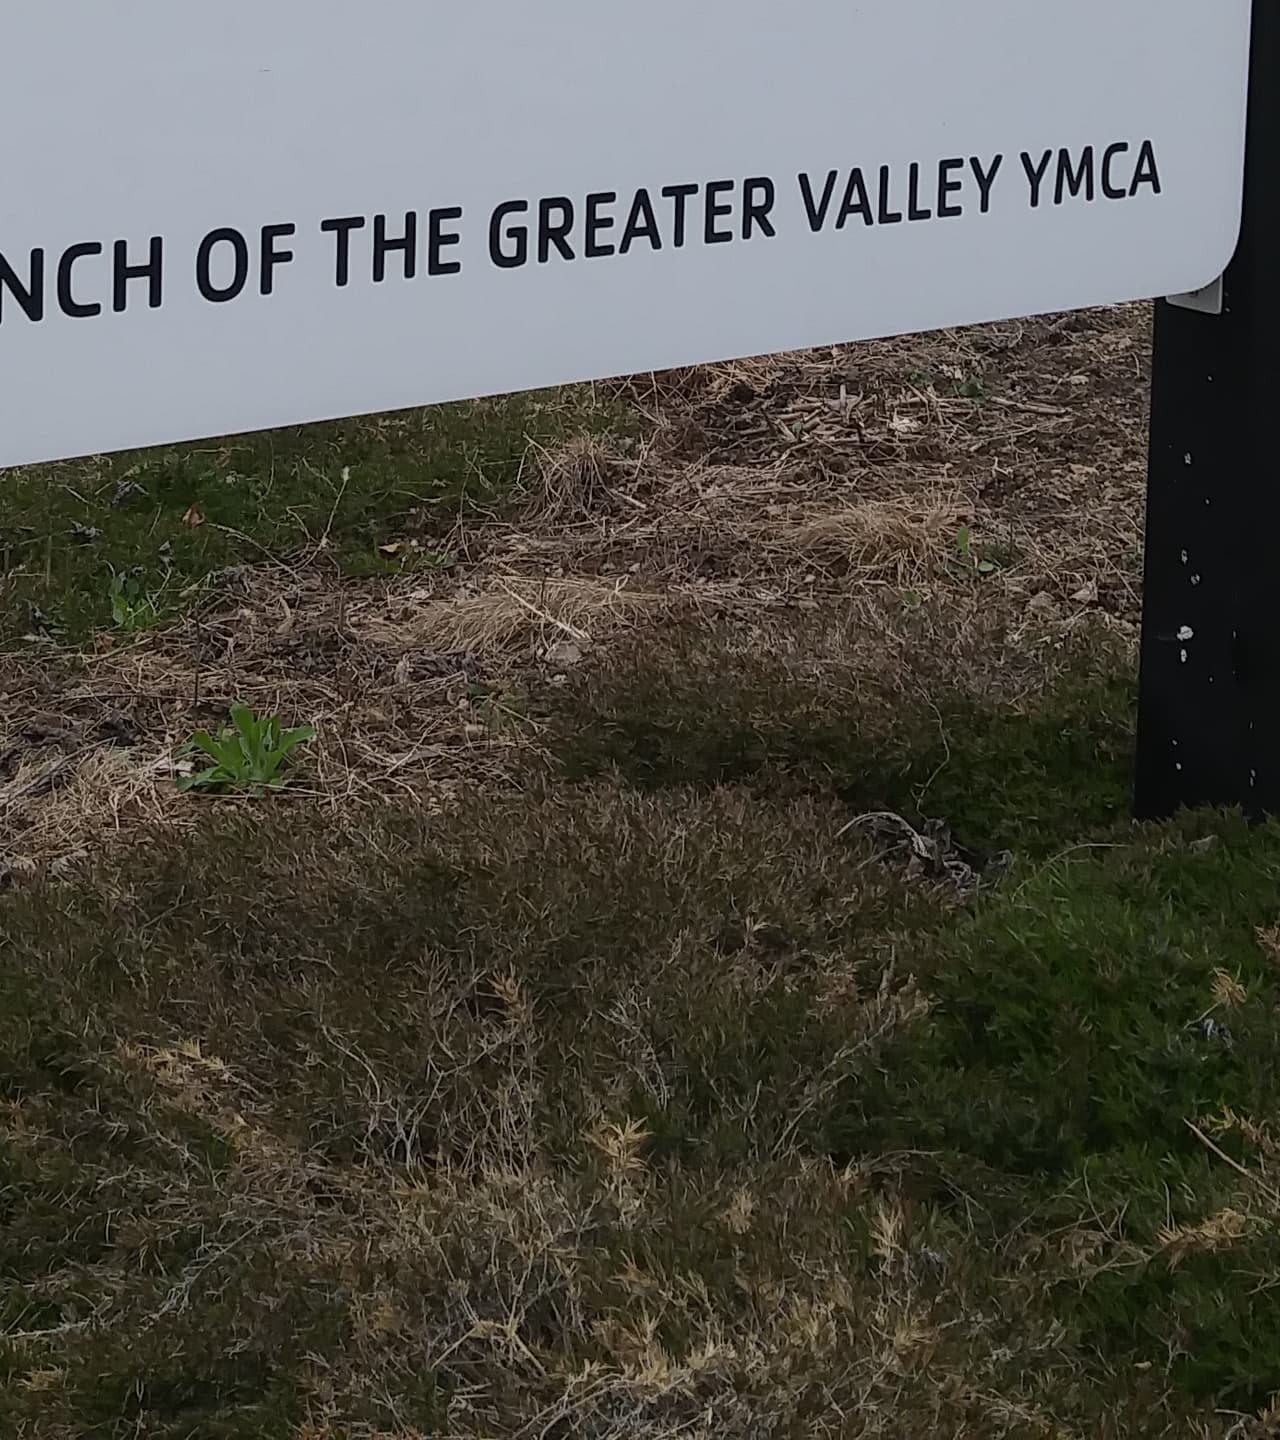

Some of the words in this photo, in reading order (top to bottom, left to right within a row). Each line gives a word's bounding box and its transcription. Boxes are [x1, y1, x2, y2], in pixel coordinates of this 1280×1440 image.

[194, 221, 298, 304] OF
[319, 205, 464, 288] THE
[487, 175, 778, 270] GREATER
[795, 153, 1005, 234] VALLEY
[1018, 138, 1163, 209] YMCA
